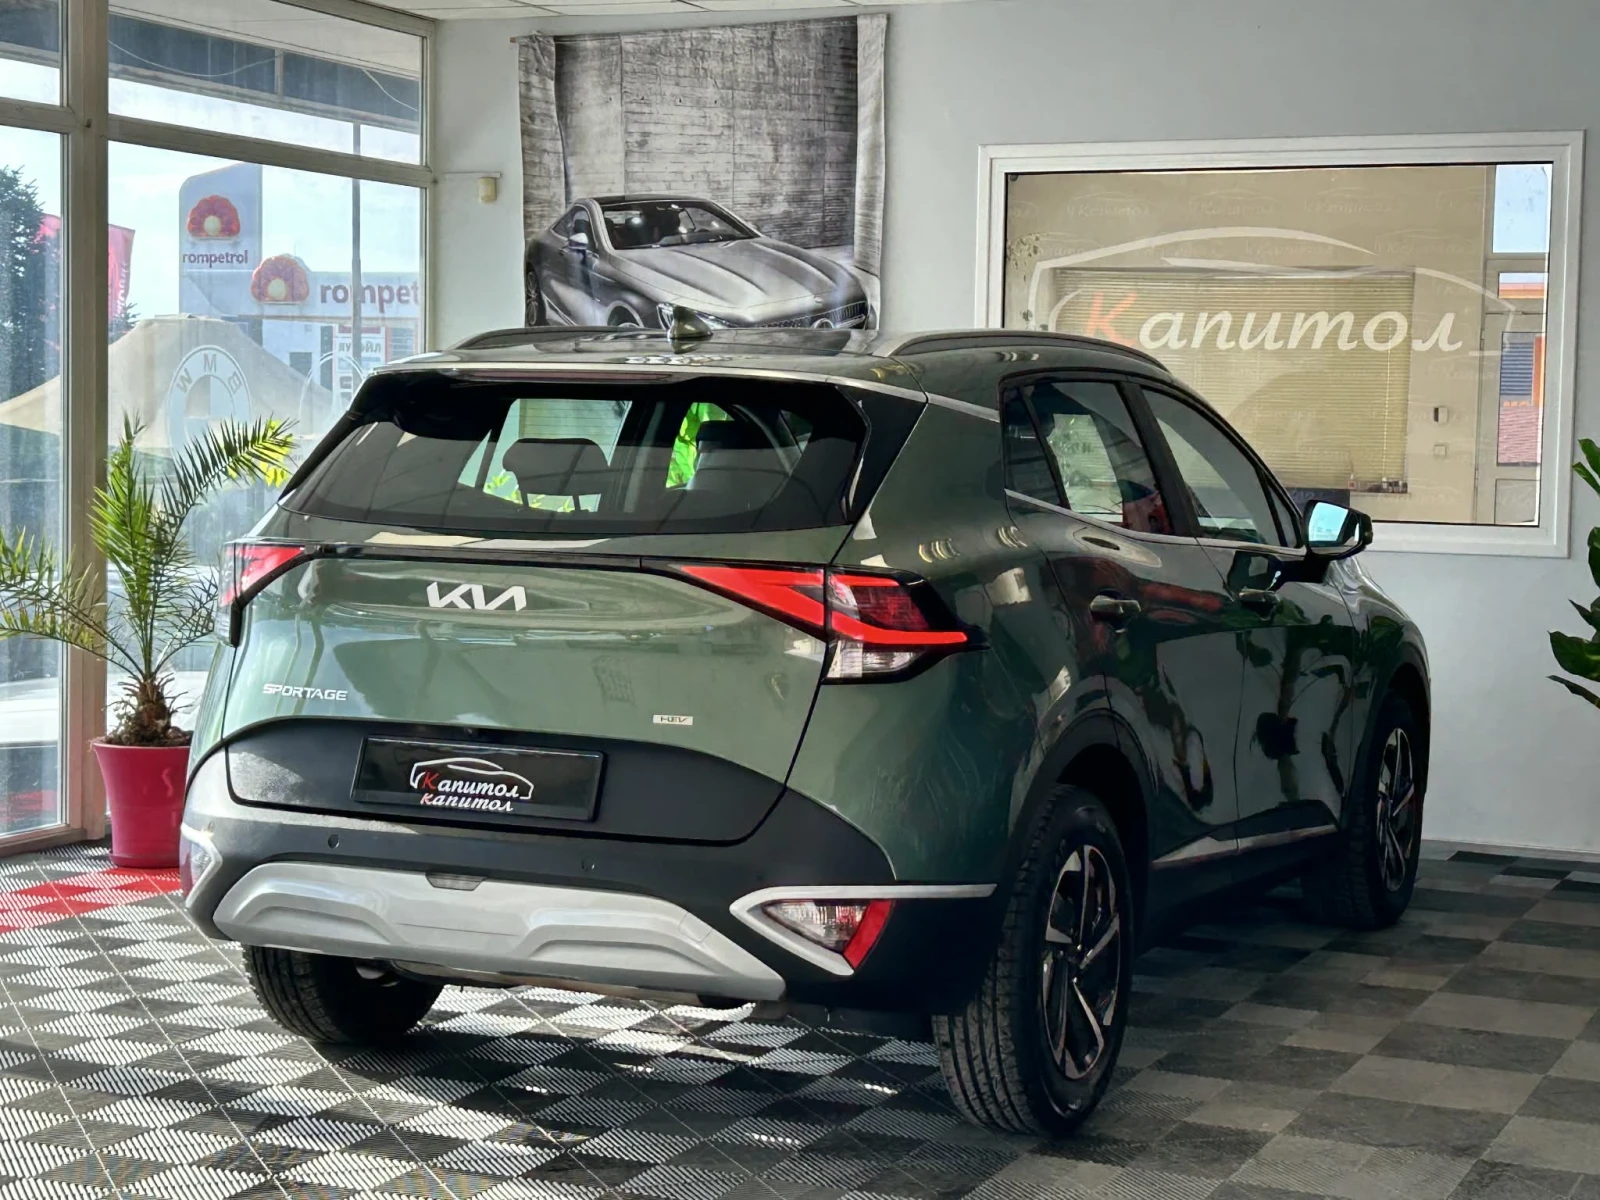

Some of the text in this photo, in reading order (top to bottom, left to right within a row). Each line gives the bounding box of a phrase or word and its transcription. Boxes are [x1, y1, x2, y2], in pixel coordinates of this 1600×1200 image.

[182, 250, 248, 268] rompetrol
[1084, 291, 1464, 352] Капитол
[426, 582, 527, 611] KIA
[262, 683, 348, 701] SPORTAGE
[422, 771, 520, 798] Капитол
